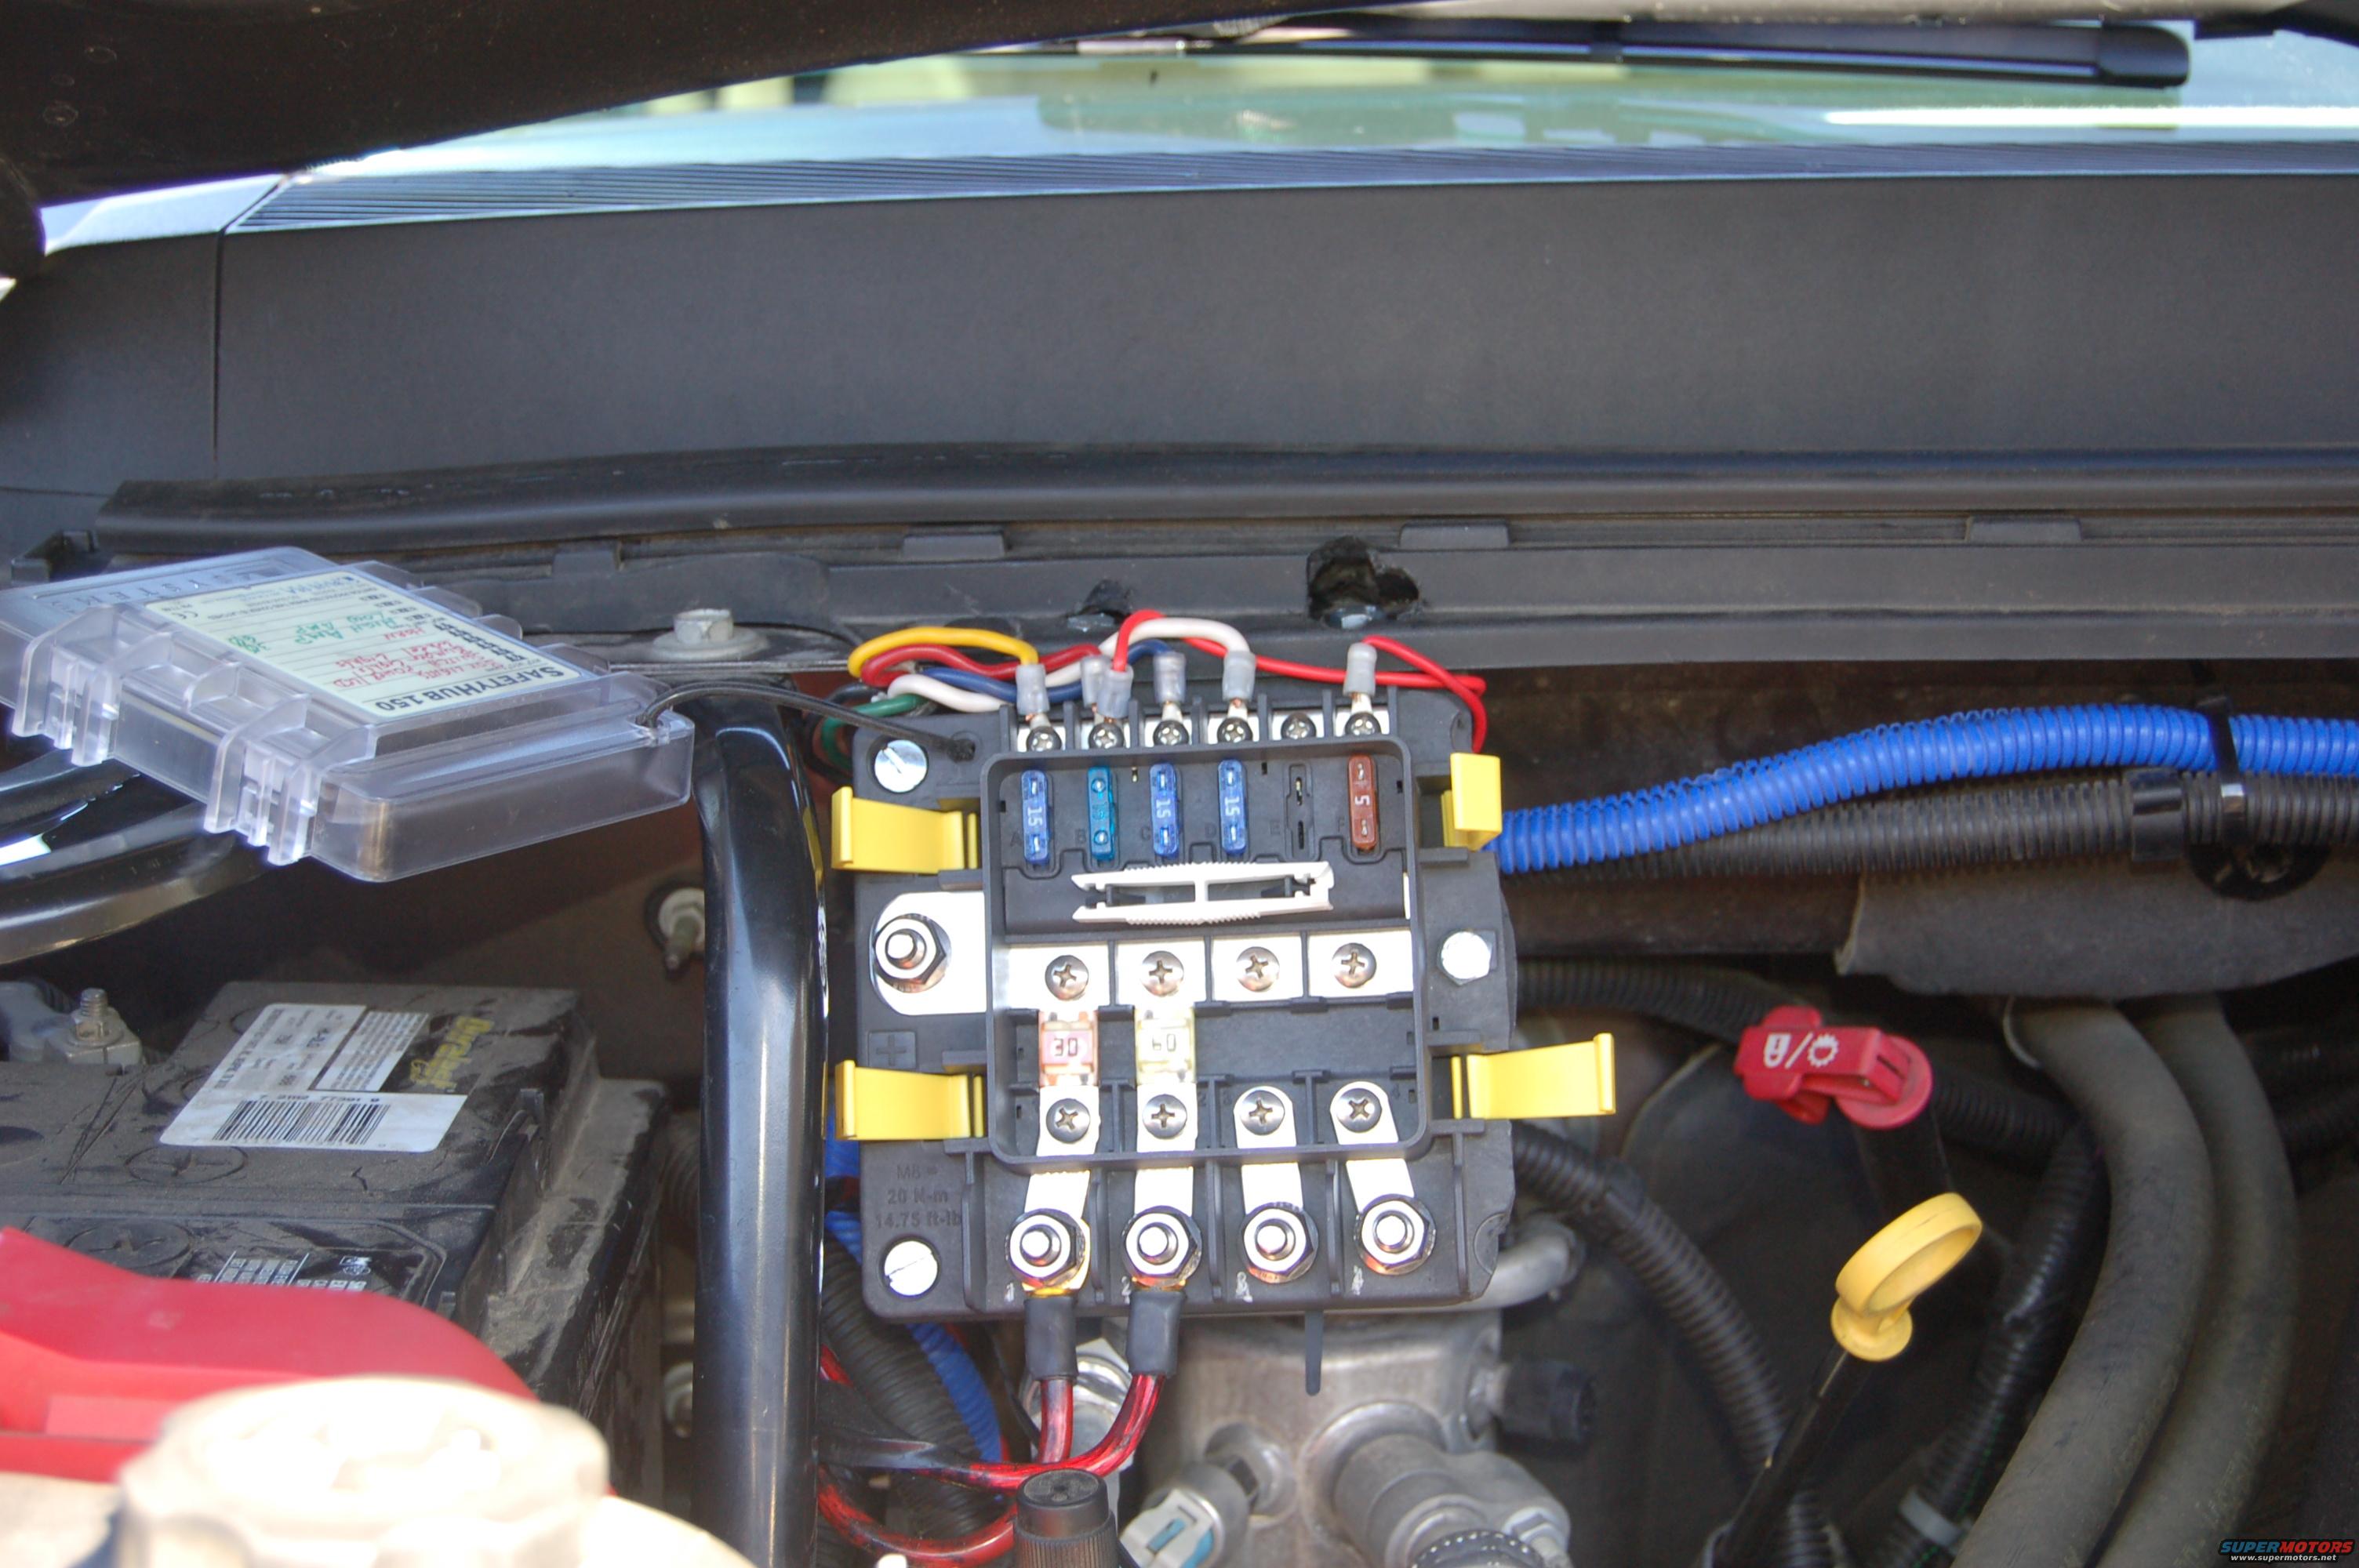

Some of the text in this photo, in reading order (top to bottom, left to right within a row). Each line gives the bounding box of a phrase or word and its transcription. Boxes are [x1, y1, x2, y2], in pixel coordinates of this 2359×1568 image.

[376, 695, 423, 712] 150
[1155, 798, 1171, 819] 15
[1224, 796, 1240, 817] 15
[1354, 794, 1370, 806] 5
[1027, 806, 1043, 827] 15
[1053, 1036, 1078, 1057] 30
[887, 1187, 907, 1205] 20
